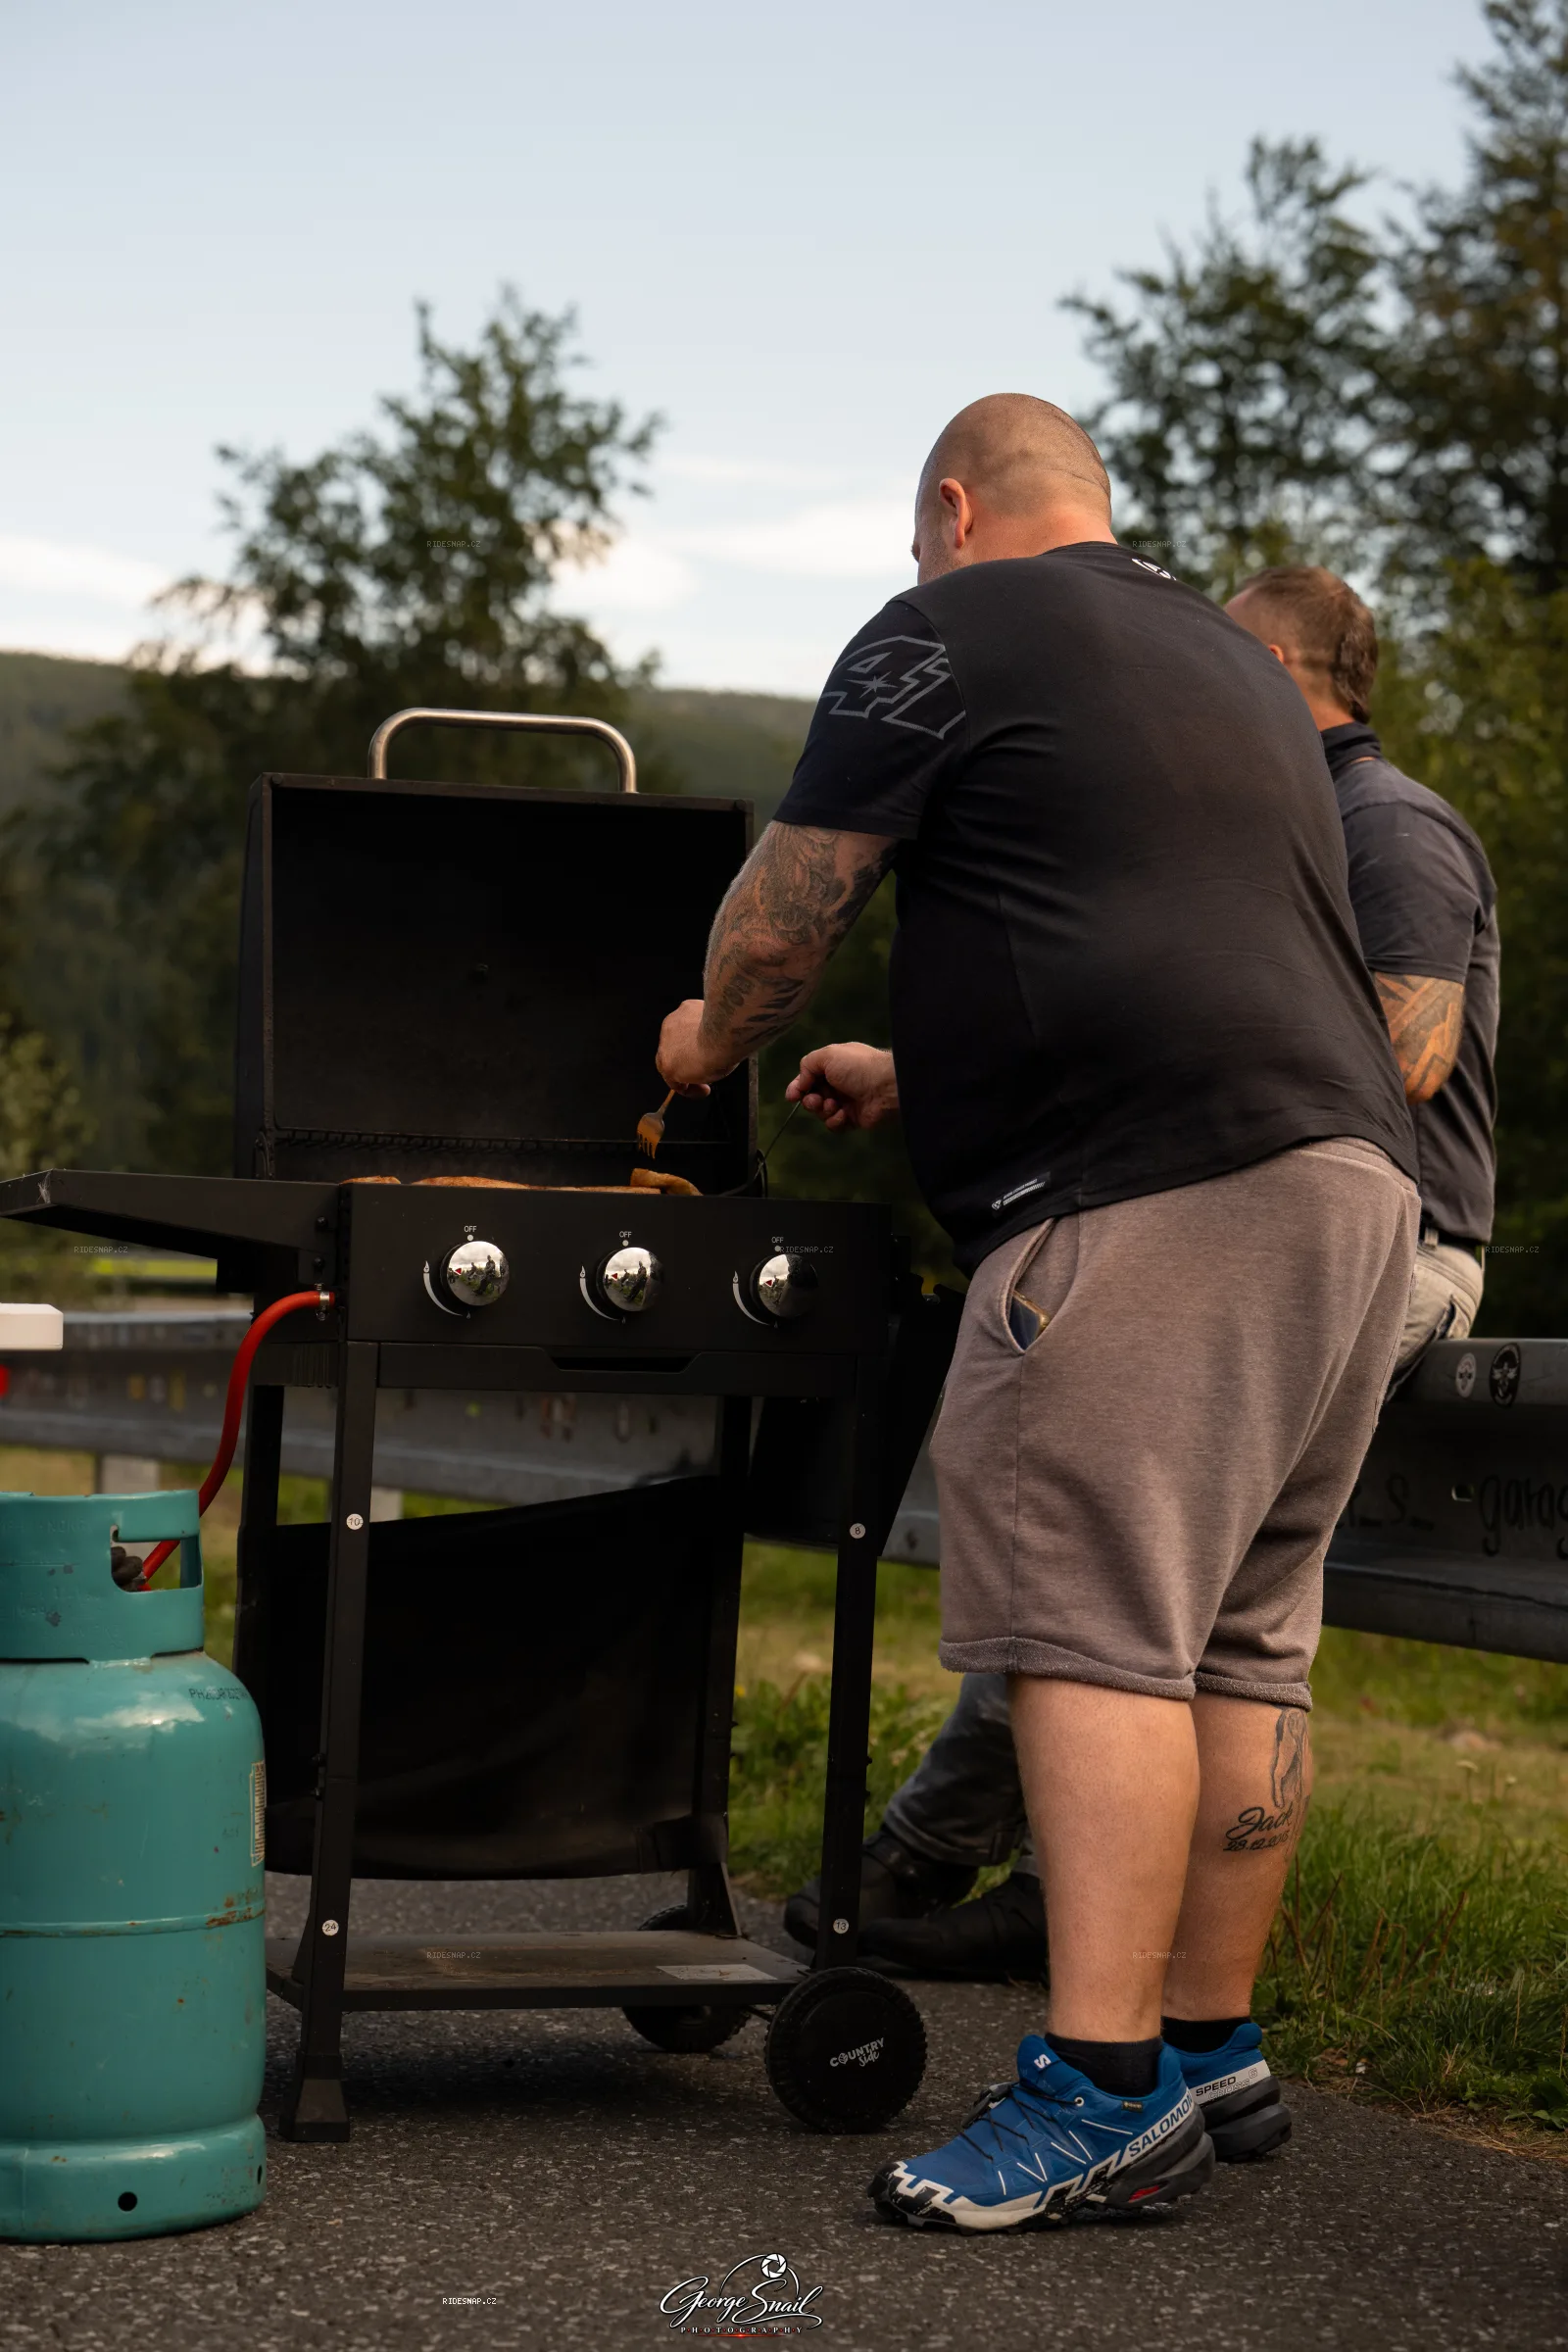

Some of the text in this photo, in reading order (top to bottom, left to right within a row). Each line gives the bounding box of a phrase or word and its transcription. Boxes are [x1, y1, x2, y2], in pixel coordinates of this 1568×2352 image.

[829, 2036, 885, 2067] COUNTRY
[858, 2048, 880, 2067] side
[1195, 2076, 1238, 2097] SPEED
[1128, 2093, 1194, 2158] SALOMON
